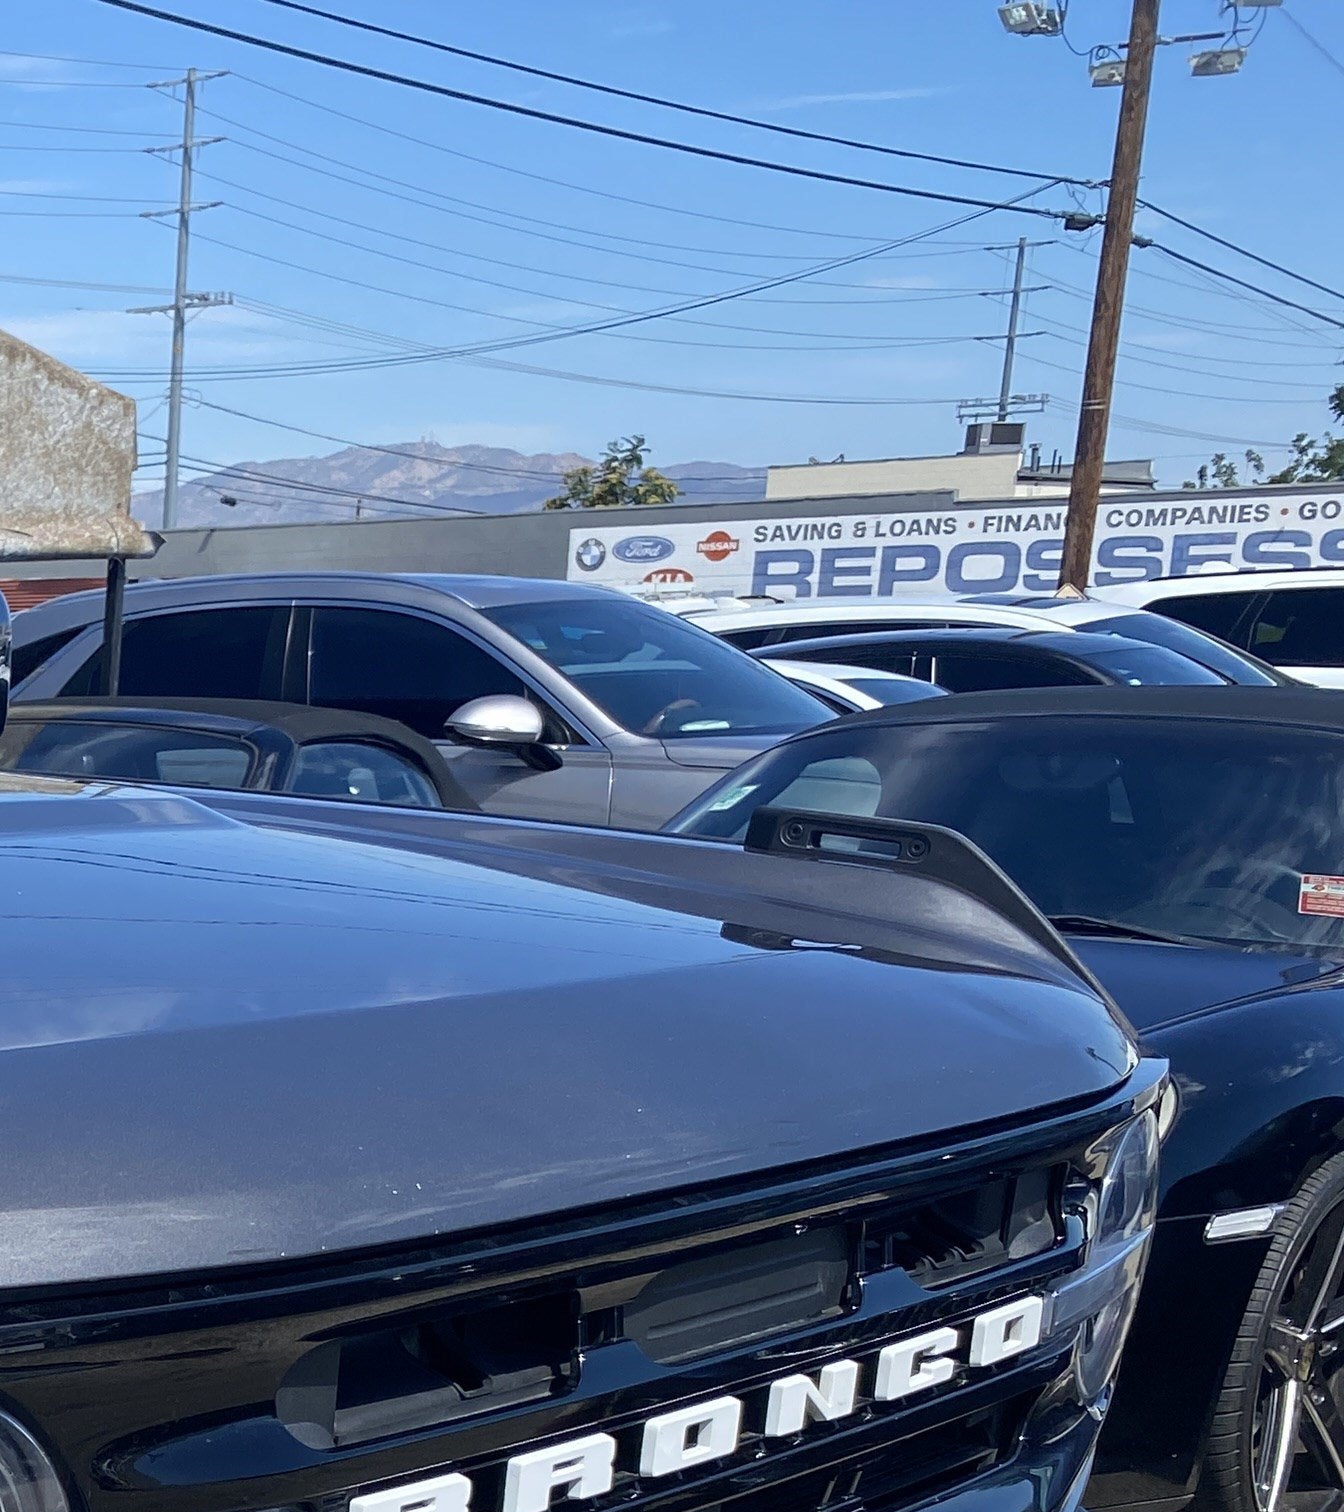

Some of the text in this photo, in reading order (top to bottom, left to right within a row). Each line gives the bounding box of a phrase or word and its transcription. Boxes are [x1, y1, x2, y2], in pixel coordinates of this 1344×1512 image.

[753, 522, 842, 543] SAVING
[852, 521, 867, 538] &
[874, 517, 957, 538] LOANS
[982, 512, 1070, 534] FINAN
[1105, 503, 1270, 528] COMPANIES
[624, 541, 662, 558] Ford
[698, 541, 738, 552] NISSAN
